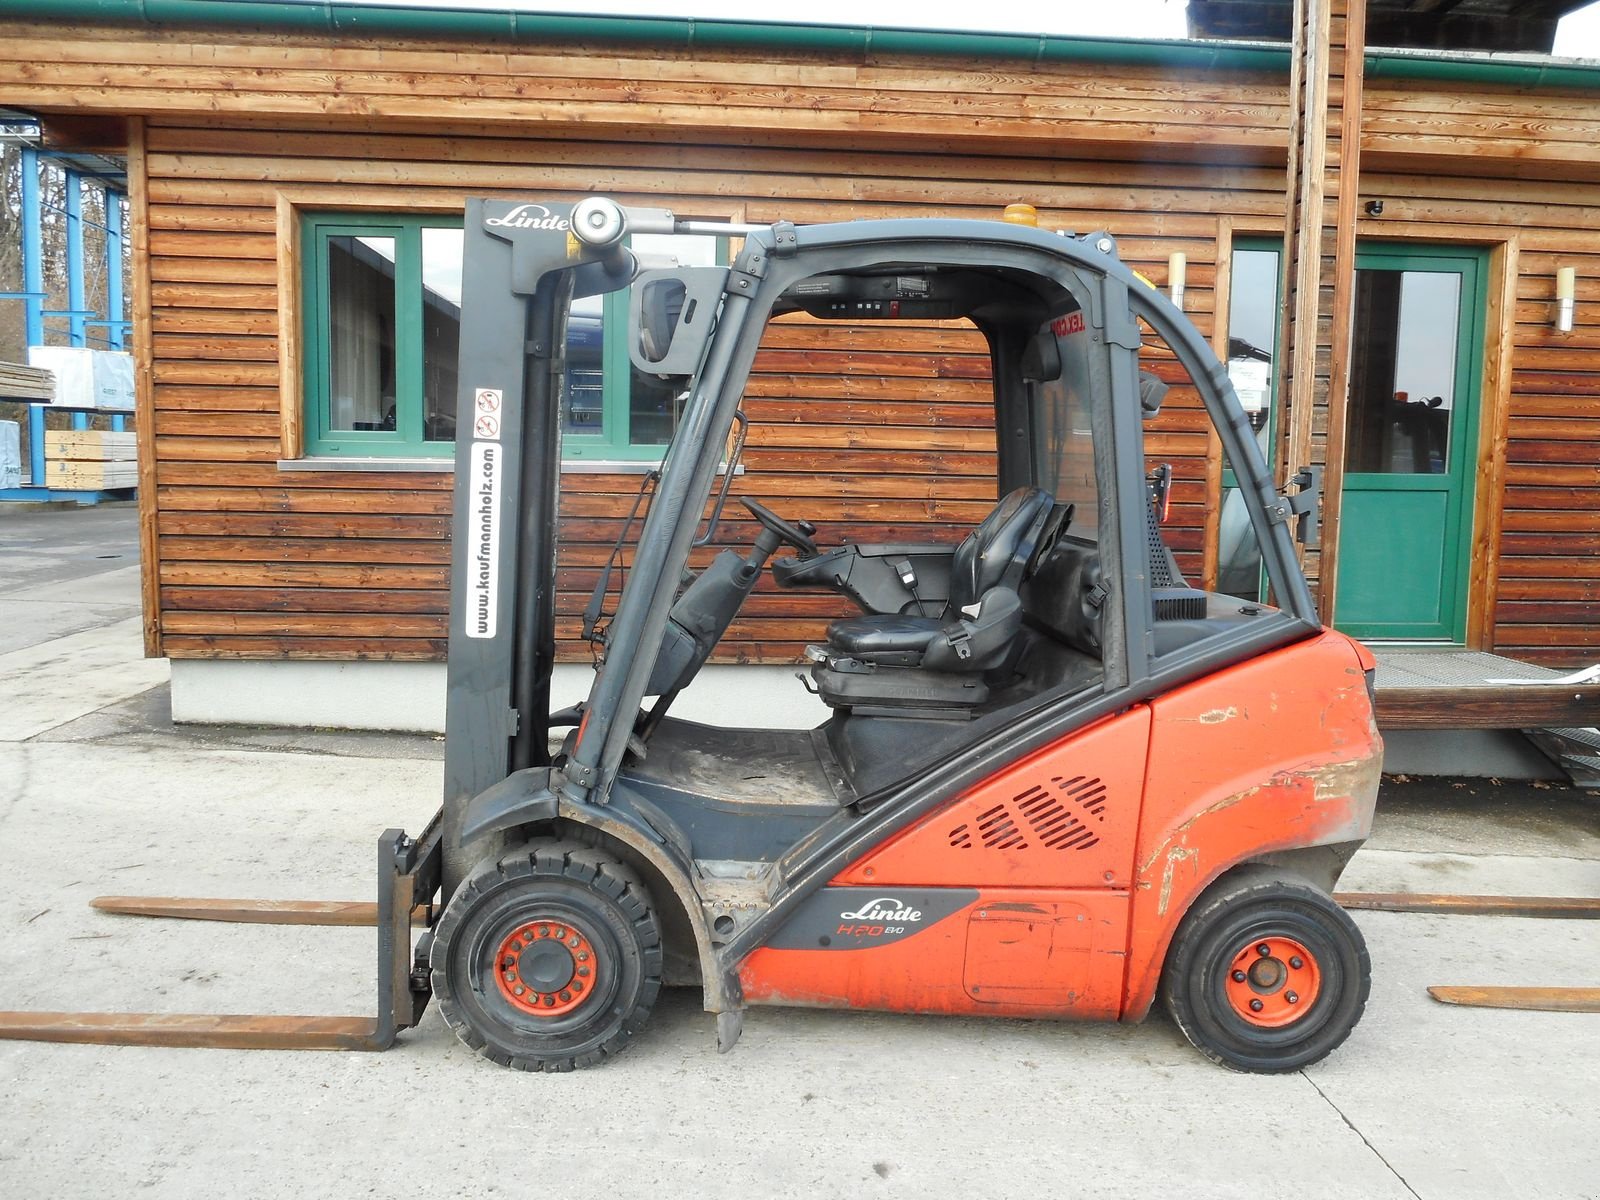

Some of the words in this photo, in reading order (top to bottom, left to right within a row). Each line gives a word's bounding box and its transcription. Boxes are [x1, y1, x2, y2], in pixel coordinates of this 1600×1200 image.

[485, 204, 569, 231] Linde
[476, 448, 494, 634] www.kaufmannholz.com
[840, 898, 922, 921] Linde
